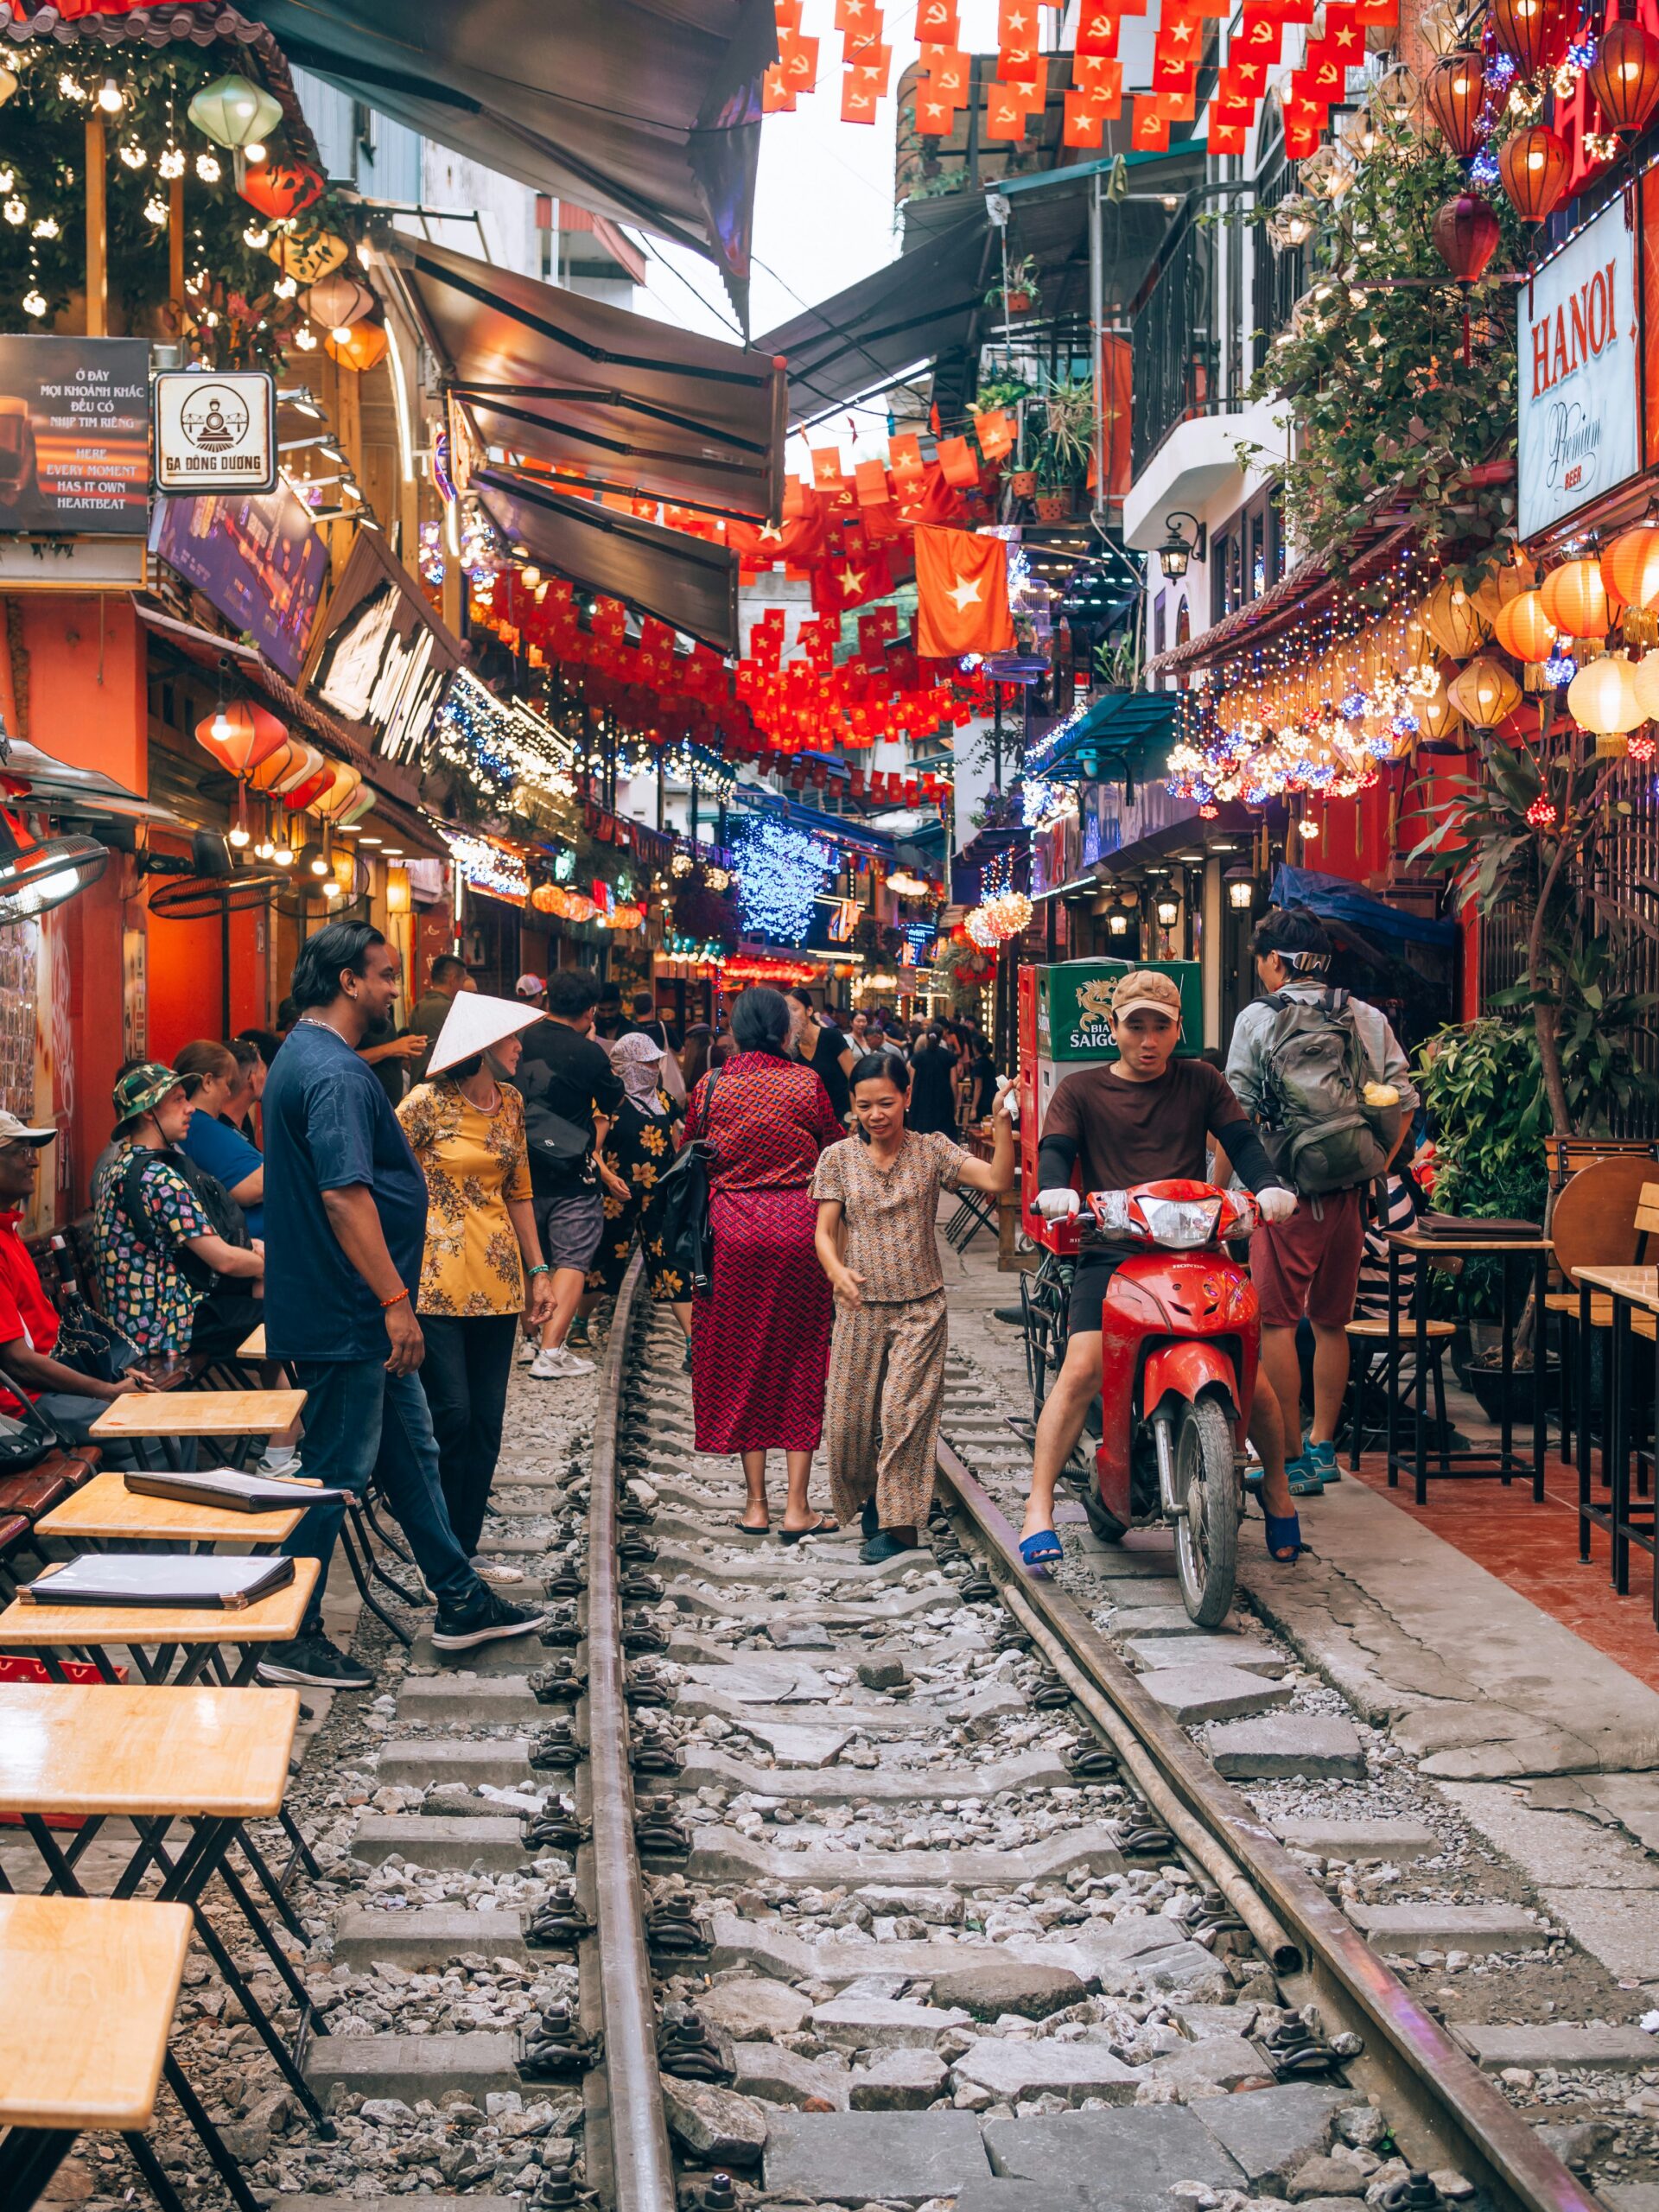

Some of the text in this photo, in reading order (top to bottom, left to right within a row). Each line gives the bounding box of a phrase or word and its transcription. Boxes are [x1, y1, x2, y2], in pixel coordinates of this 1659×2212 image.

[1530, 257, 1618, 401] HANOI
[87, 369, 110, 381] ĐÂY
[40, 385, 61, 397] MỌI
[113, 385, 144, 397] KHÁC
[97, 400, 115, 412] CÓ
[50, 416, 135, 429] NHỊP TIM RIÊNG
[1546, 402, 1601, 489] Premium
[75, 448, 107, 460] HERE
[166, 454, 262, 471] GA ĐÔNG DƯƠNG
[46, 464, 137, 477] EVERY MOMENT
[1564, 464, 1582, 491] BEER
[57, 481, 126, 493] HAS IT OWN
[57, 498, 126, 510] HEARTBEAT
[1090, 1024, 1110, 1033] BIA
[1070, 1033, 1118, 1048] SAIGO
